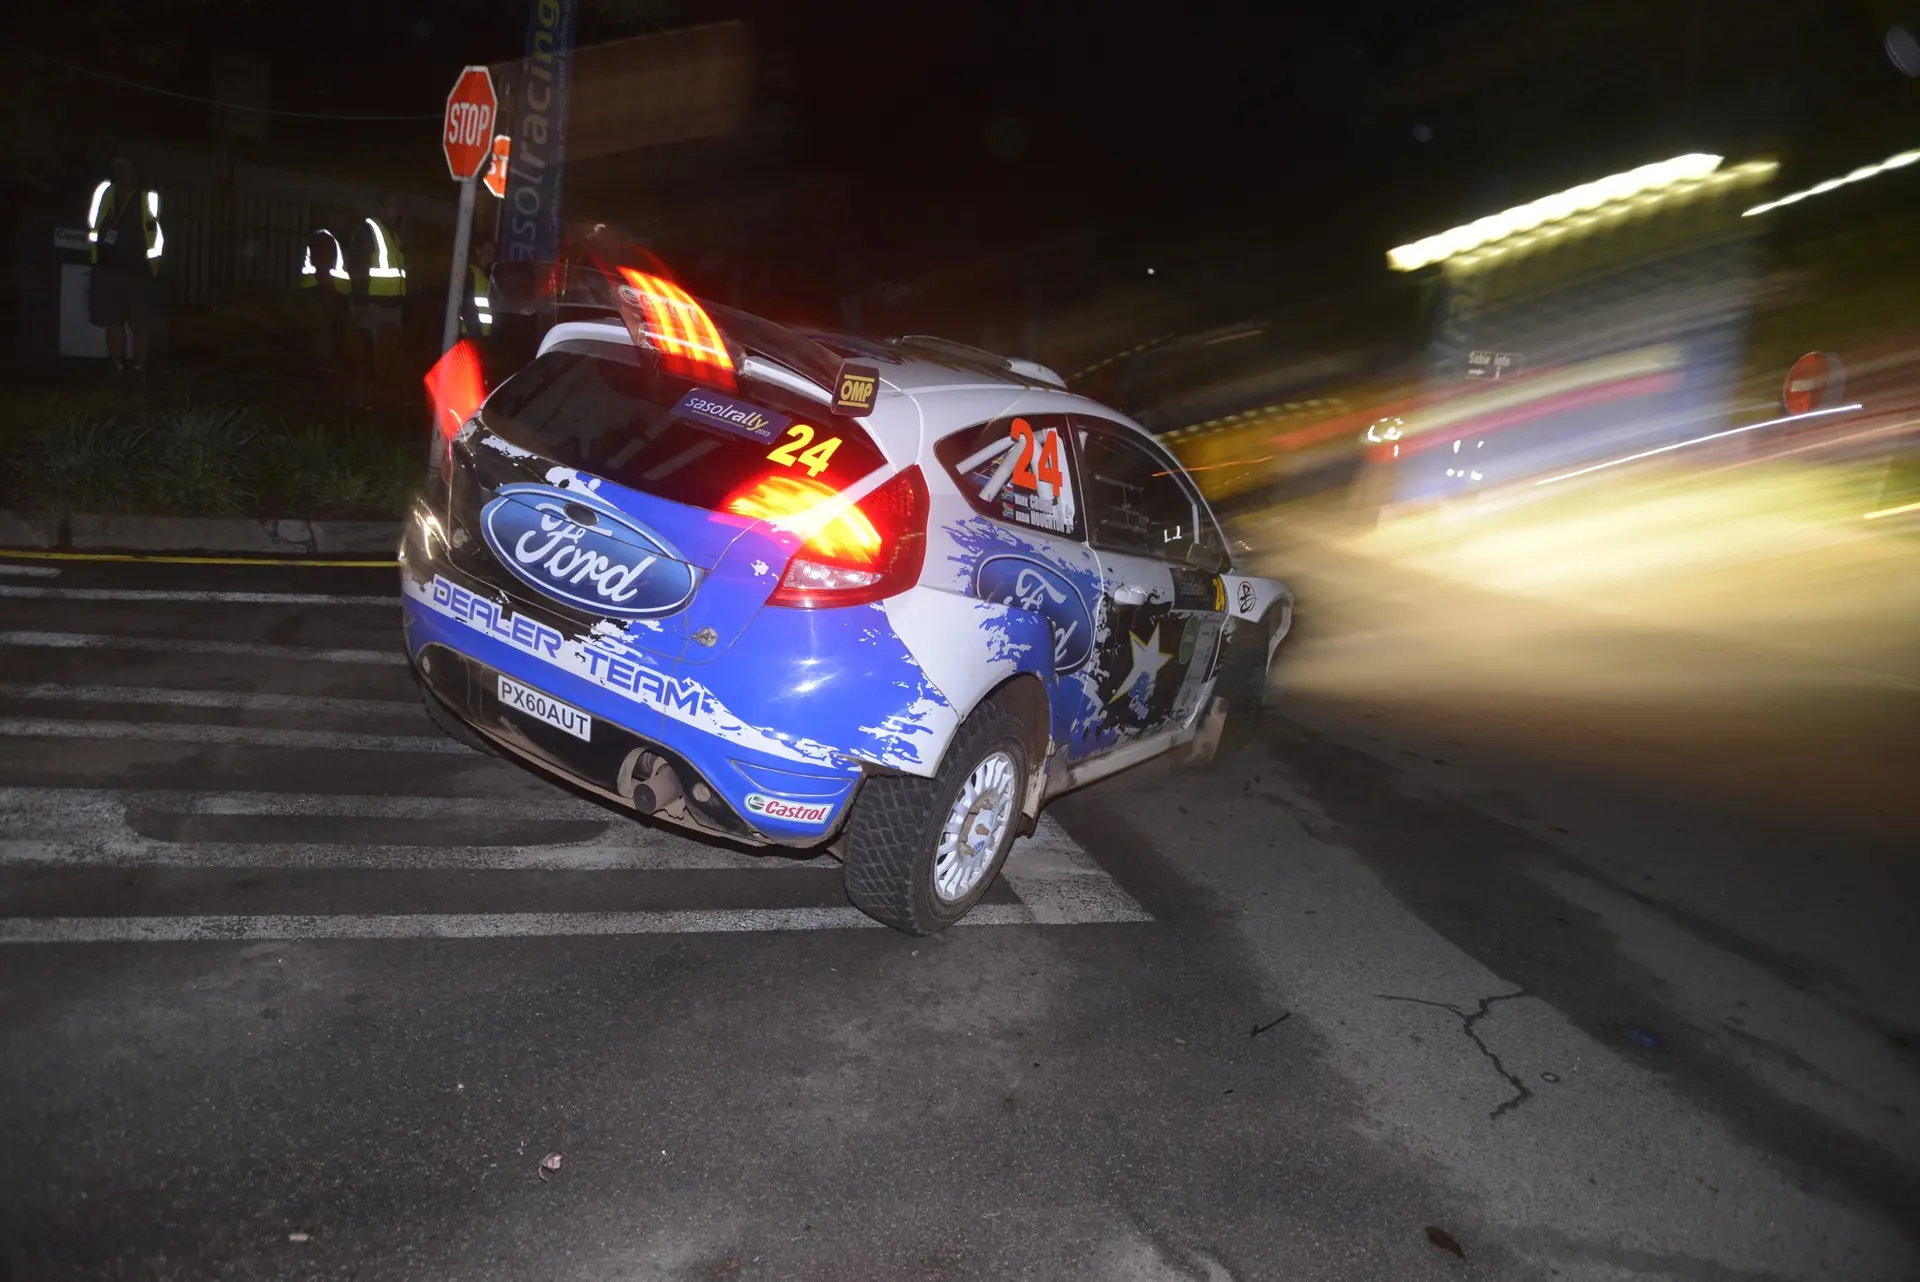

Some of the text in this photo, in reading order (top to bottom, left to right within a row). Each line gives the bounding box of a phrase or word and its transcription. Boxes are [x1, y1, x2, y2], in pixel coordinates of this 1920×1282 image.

[449, 103, 490, 146] STOP
[511, 0, 559, 260] asolracing
[685, 396, 769, 431] sasolrally
[755, 427, 771, 437] 2013
[841, 380, 873, 402] OMP
[767, 424, 843, 477] 24
[1011, 418, 1063, 497] 24
[516, 503, 656, 602] Ford
[433, 573, 703, 717] DEALER TEAM
[501, 679, 589, 738] PX60AUT
[764, 799, 827, 823] Castrol
